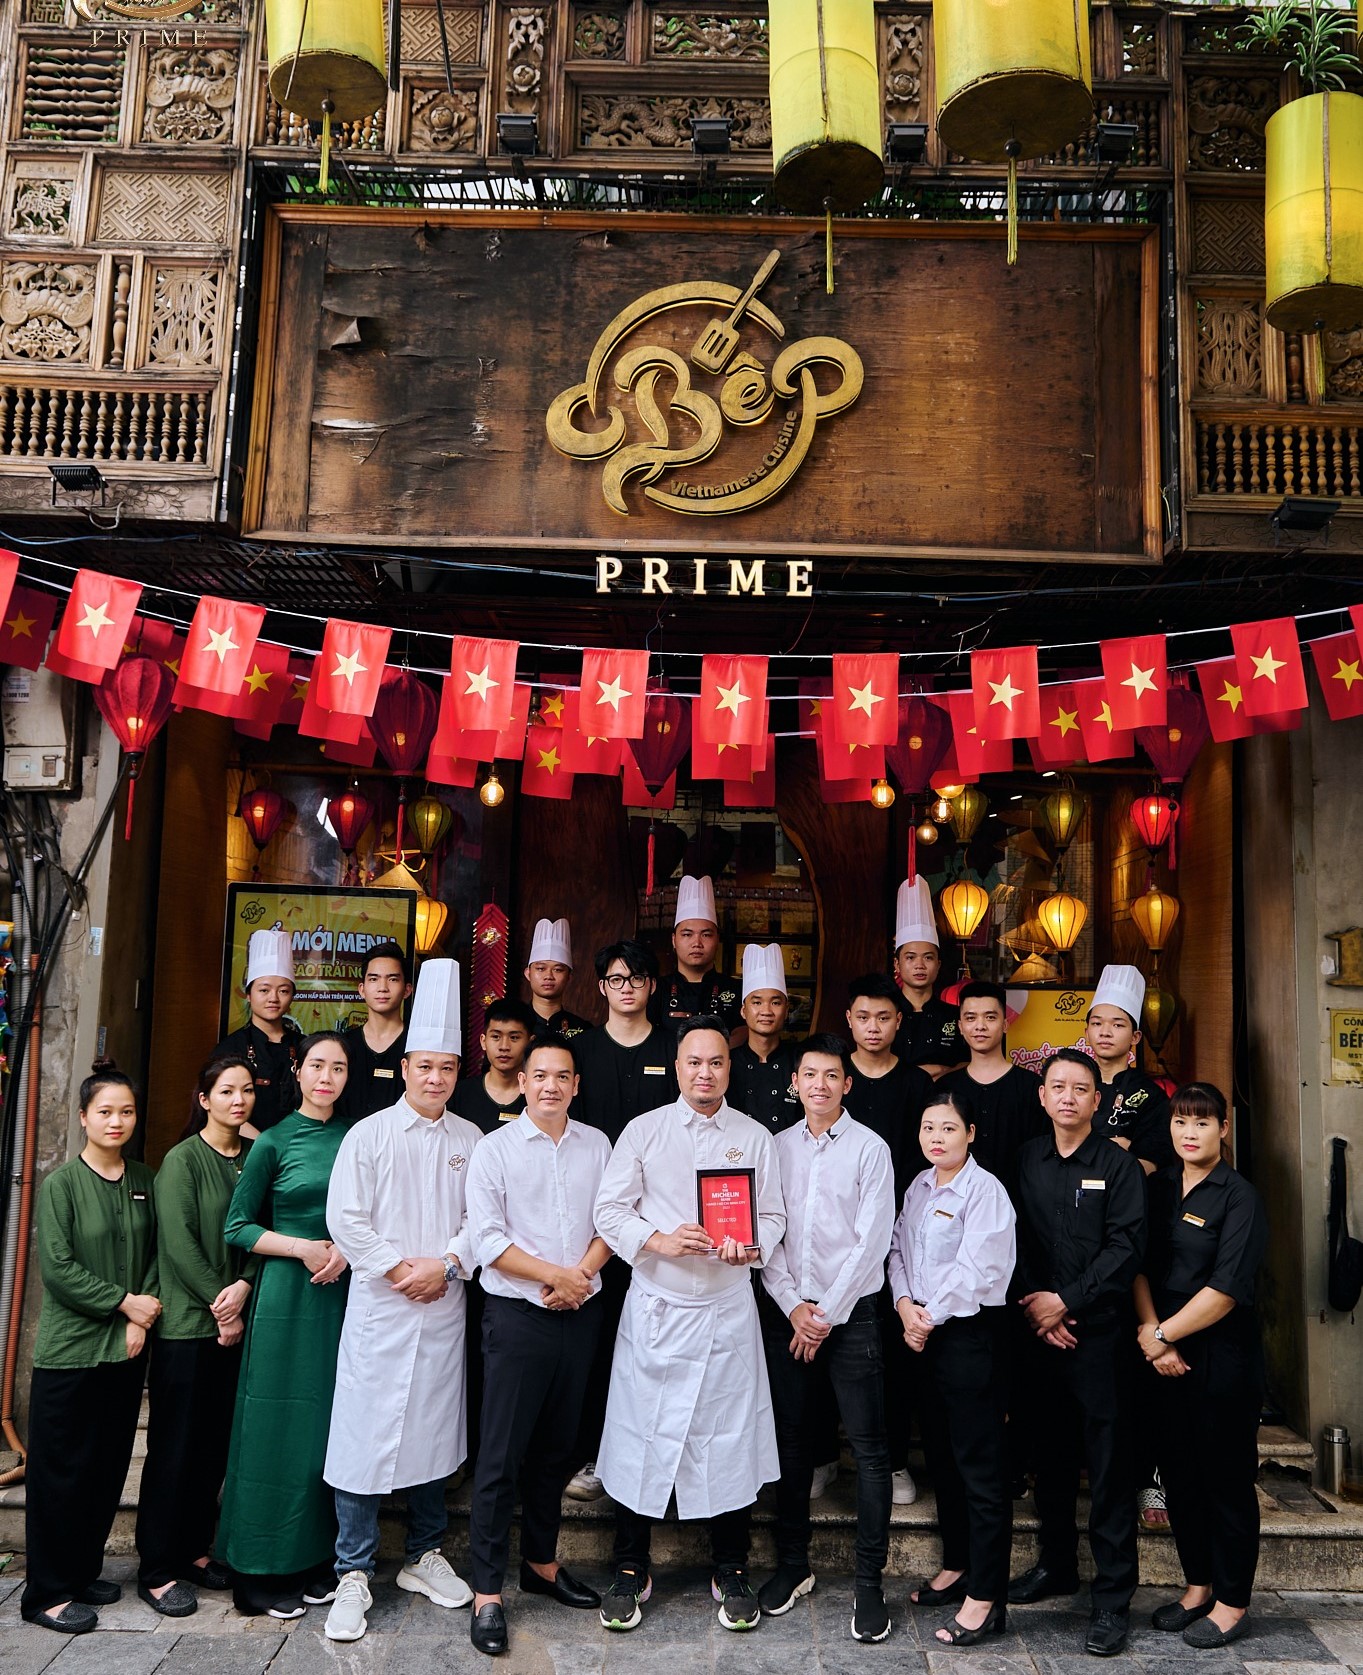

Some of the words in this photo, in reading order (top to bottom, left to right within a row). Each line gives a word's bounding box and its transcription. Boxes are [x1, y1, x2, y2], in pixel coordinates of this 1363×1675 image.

[670, 465, 767, 498] Vietnamese
[763, 410, 798, 468] Cuisine
[596, 556, 813, 597] PRIME
[292, 925, 333, 952] MỚI
[318, 961, 346, 978] TRẢI
[1012, 1048, 1040, 1065] Xua
[1041, 1043, 1064, 1058] ta
